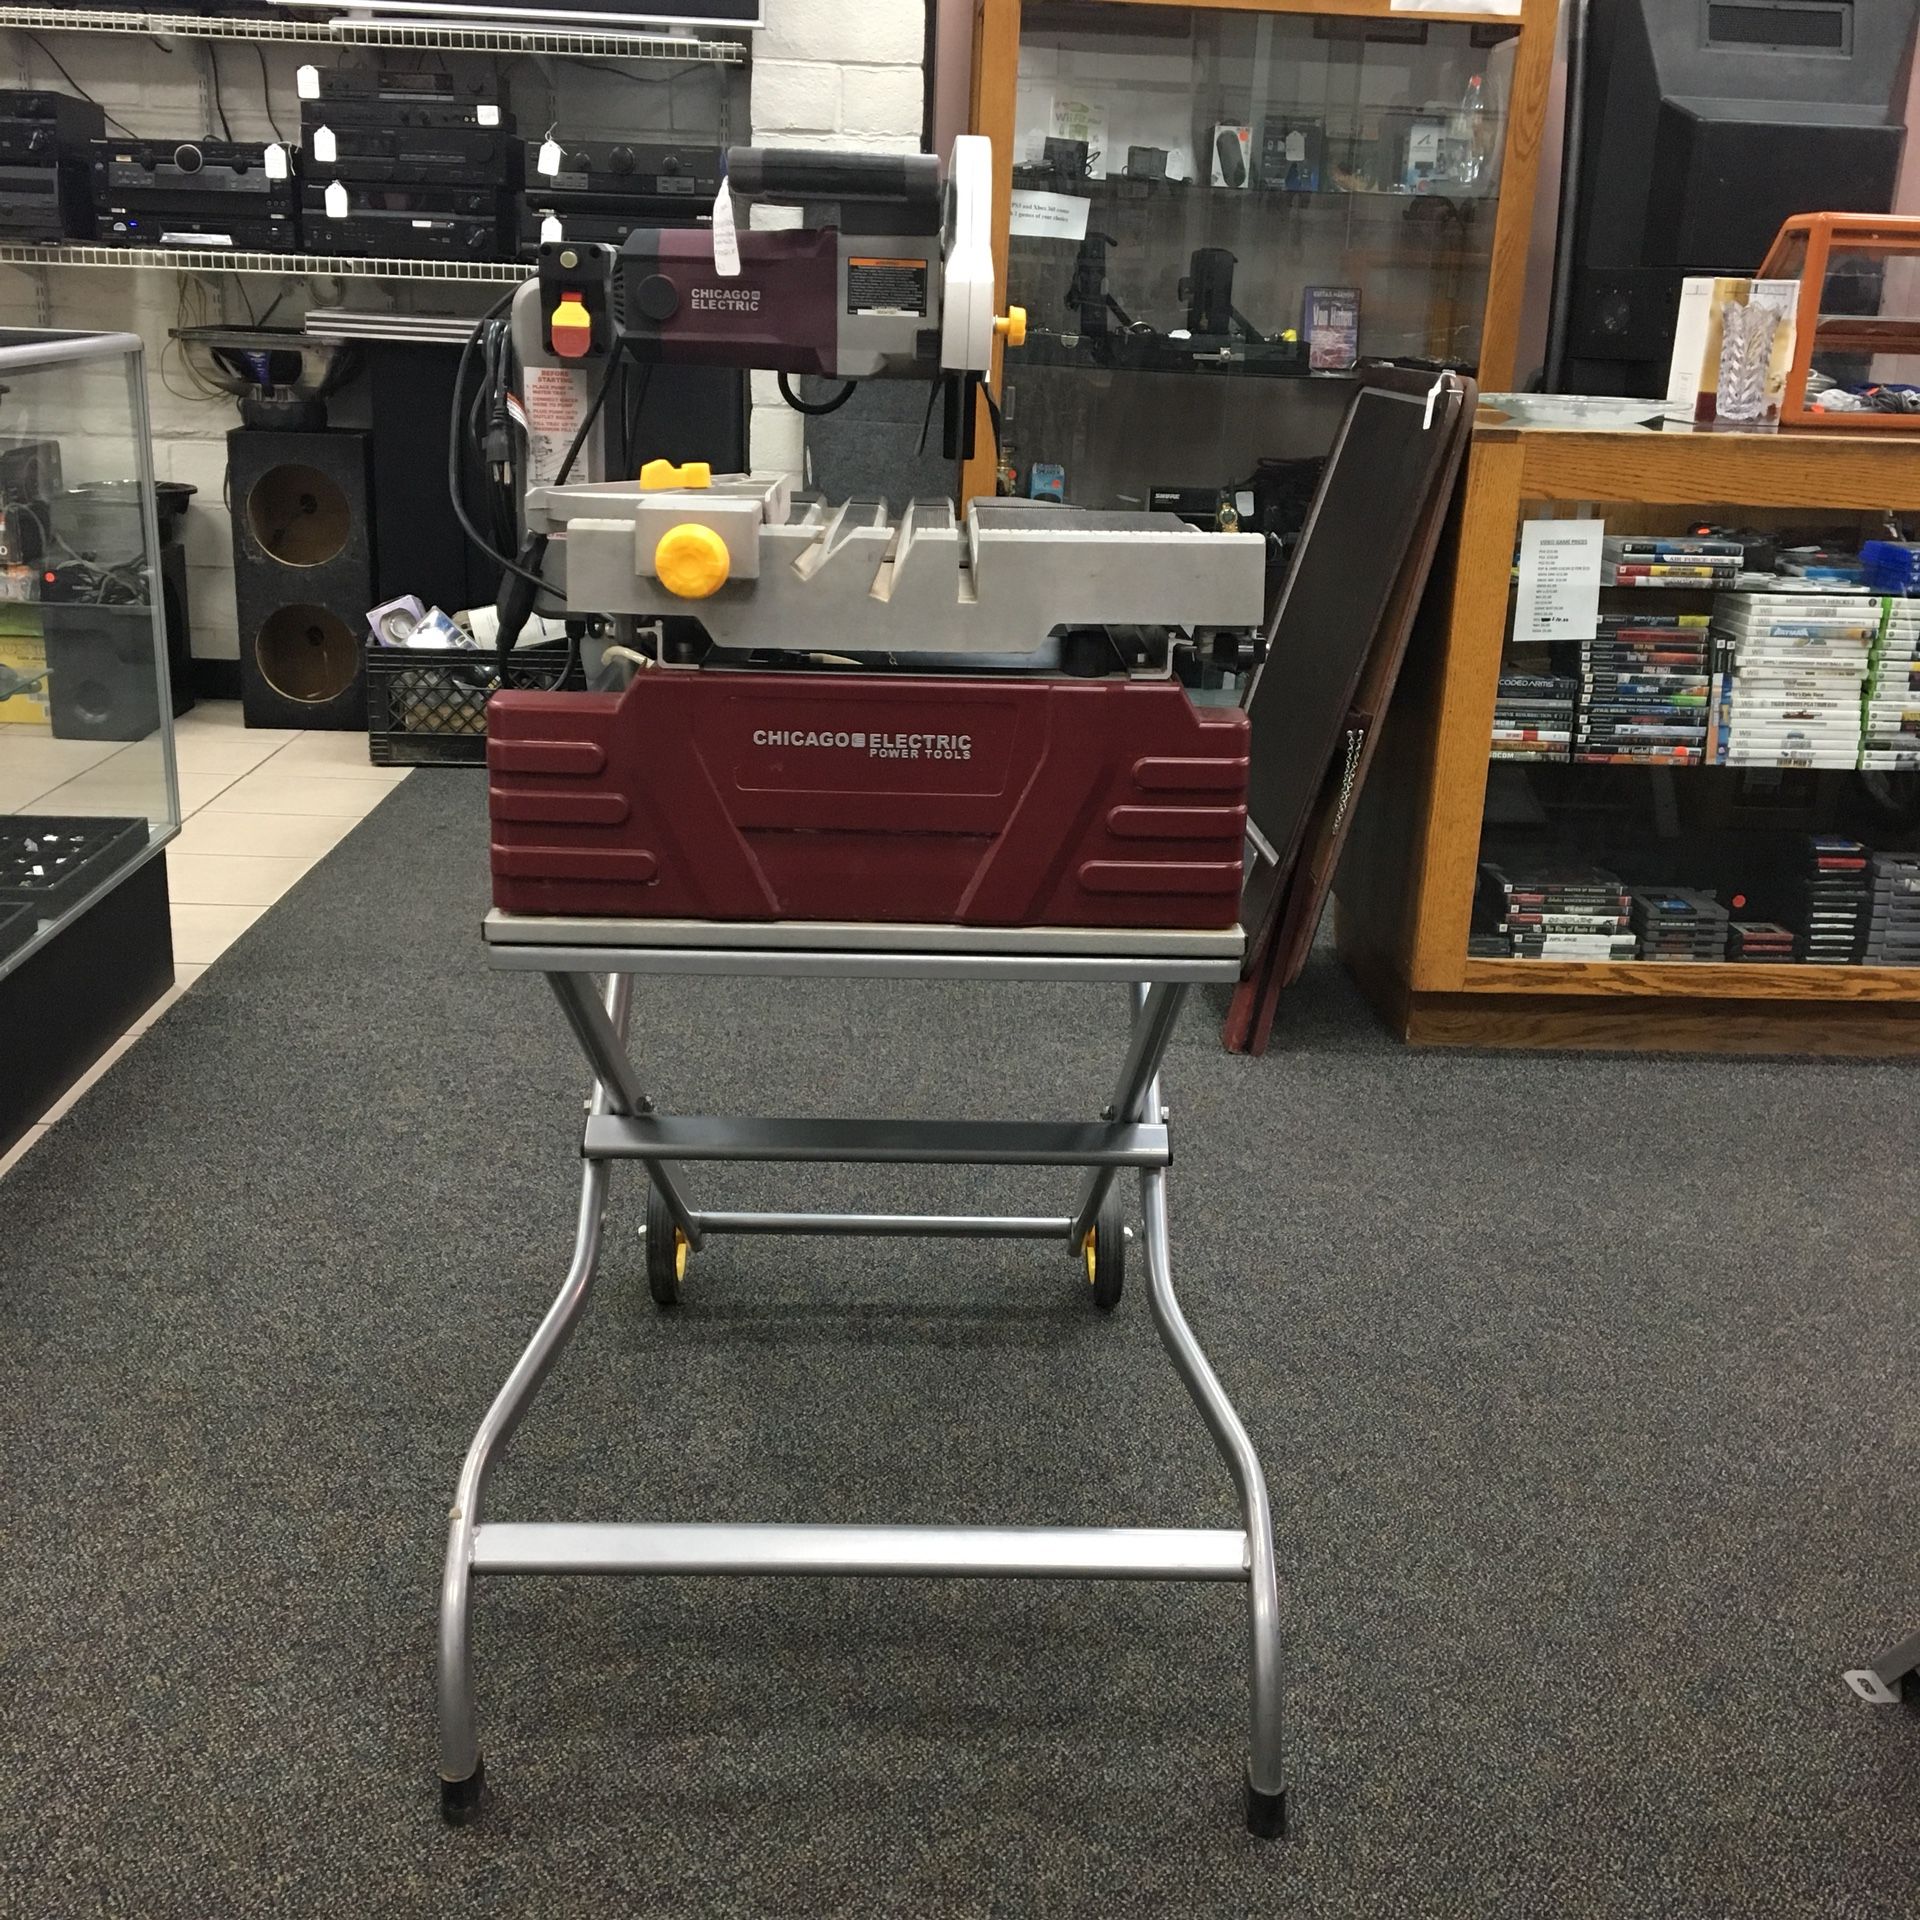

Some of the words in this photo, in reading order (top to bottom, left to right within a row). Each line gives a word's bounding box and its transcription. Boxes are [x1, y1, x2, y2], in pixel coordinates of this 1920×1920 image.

[691, 288, 750, 300] CHICAGO
[691, 299, 759, 311] ELECTRIC
[1499, 679, 1528, 687] CODED
[1528, 680, 1554, 688] ARMS
[753, 730, 850, 747] CHICAGO
[869, 733, 972, 750] ELECTRIC
[869, 749, 919, 758] POWER
[924, 750, 972, 759] TOOLS
